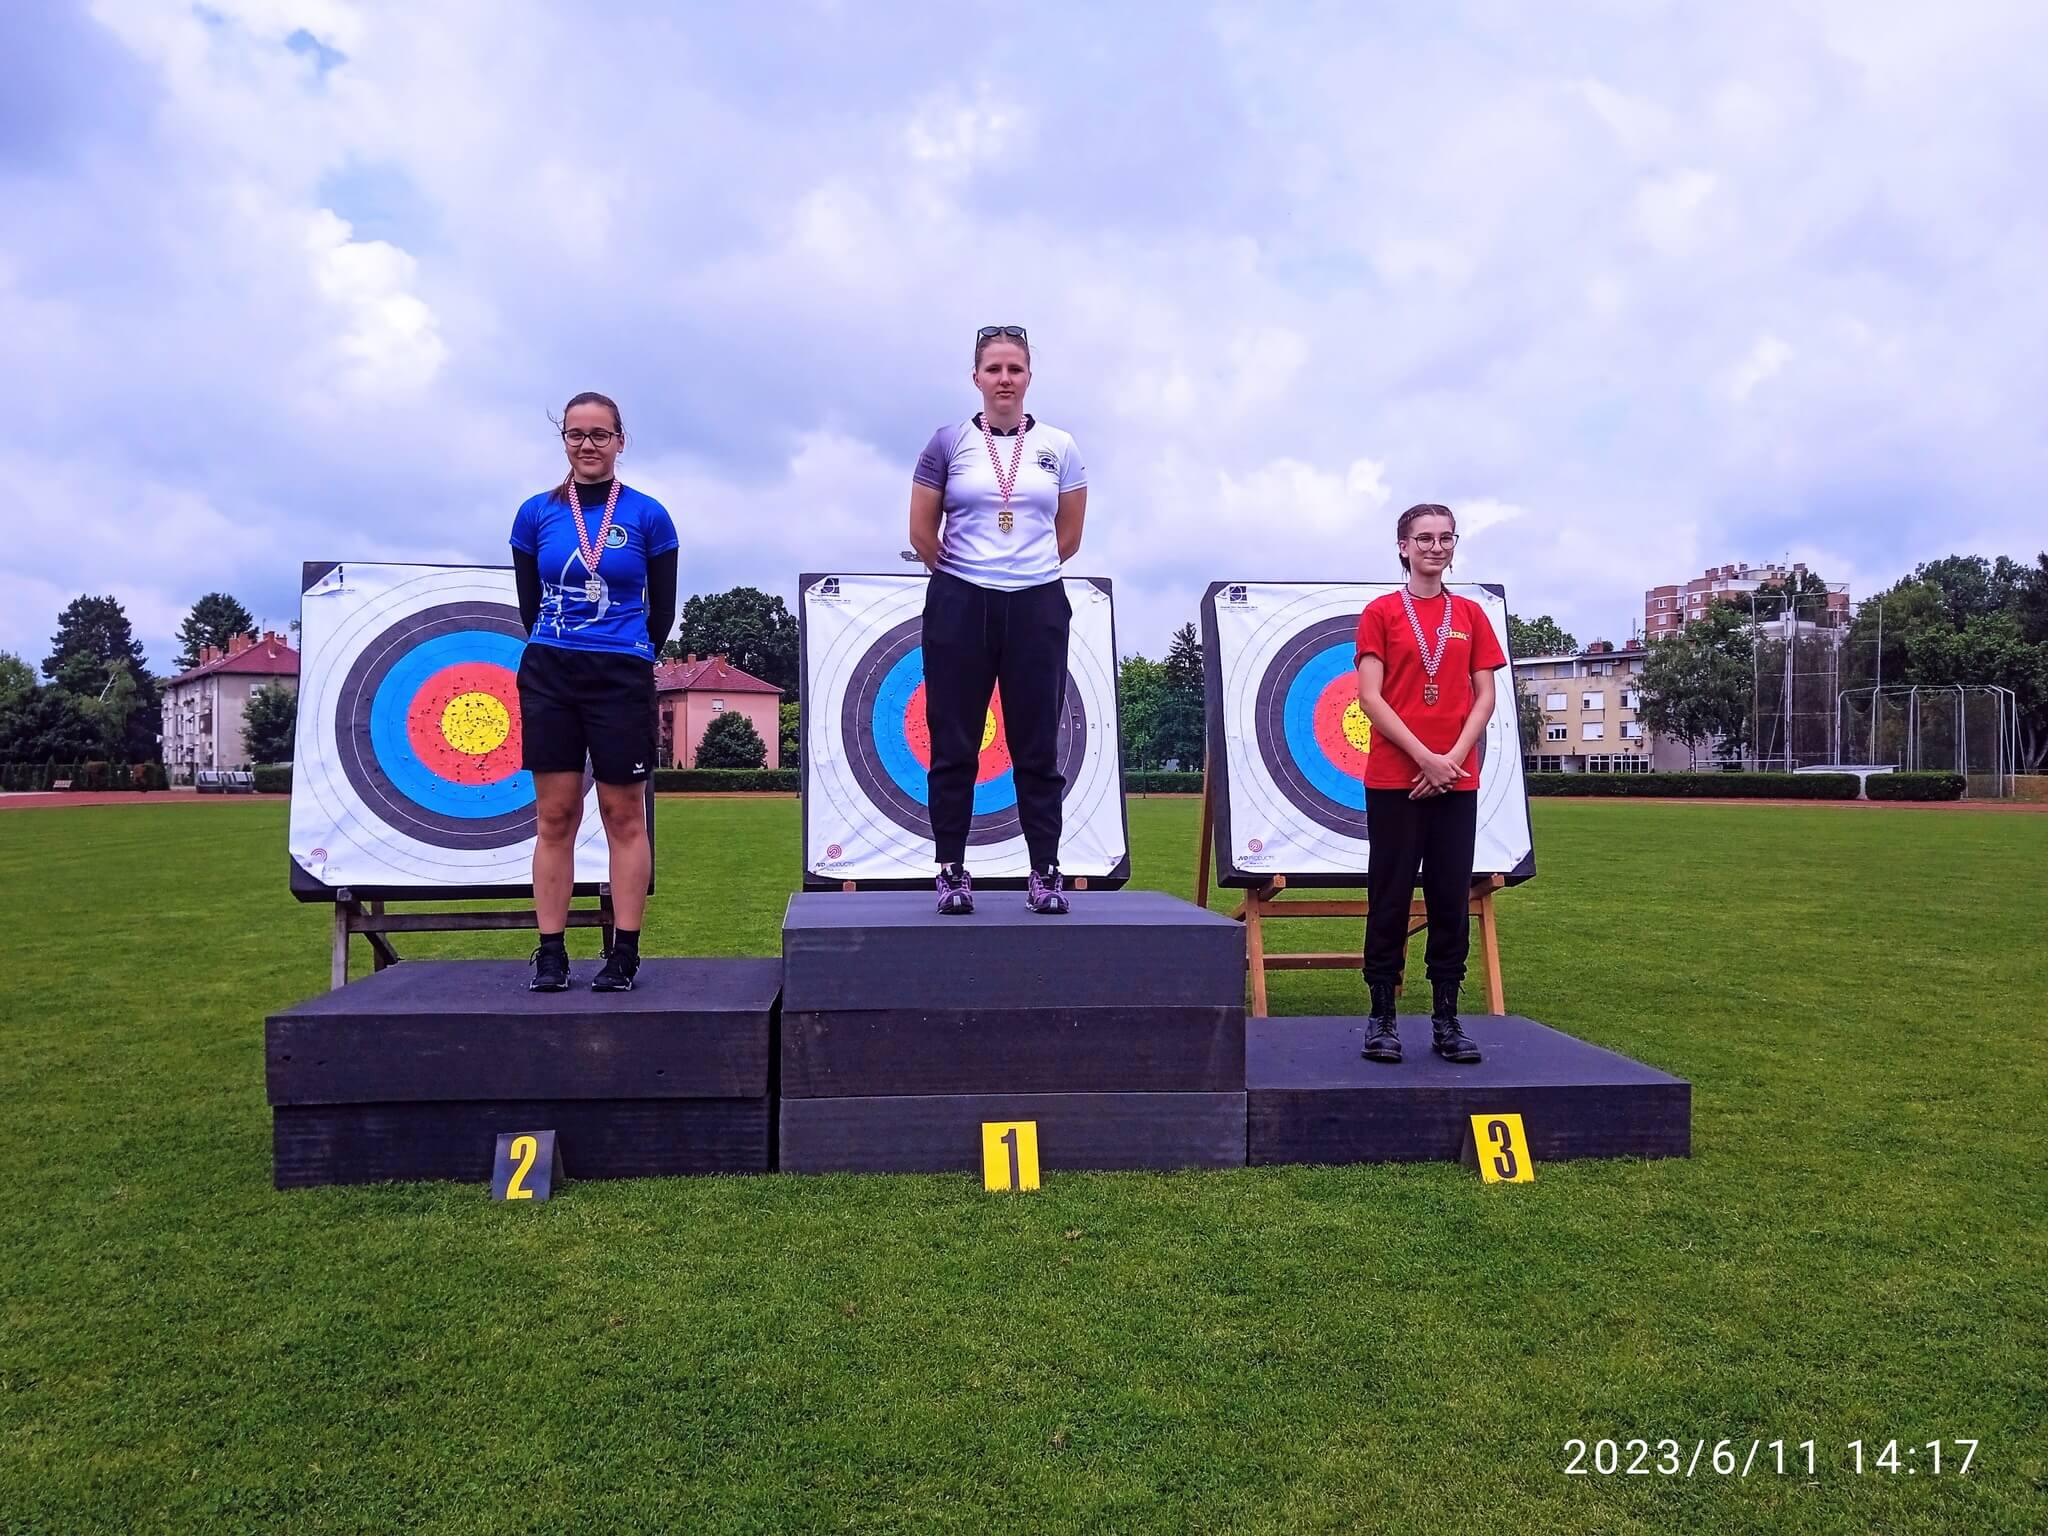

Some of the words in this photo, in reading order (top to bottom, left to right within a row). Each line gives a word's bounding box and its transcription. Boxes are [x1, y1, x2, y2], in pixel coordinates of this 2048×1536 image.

[506, 1136, 537, 1200] 2
[1001, 1128, 1020, 1192] 1
[1488, 1120, 1518, 1179] 3
